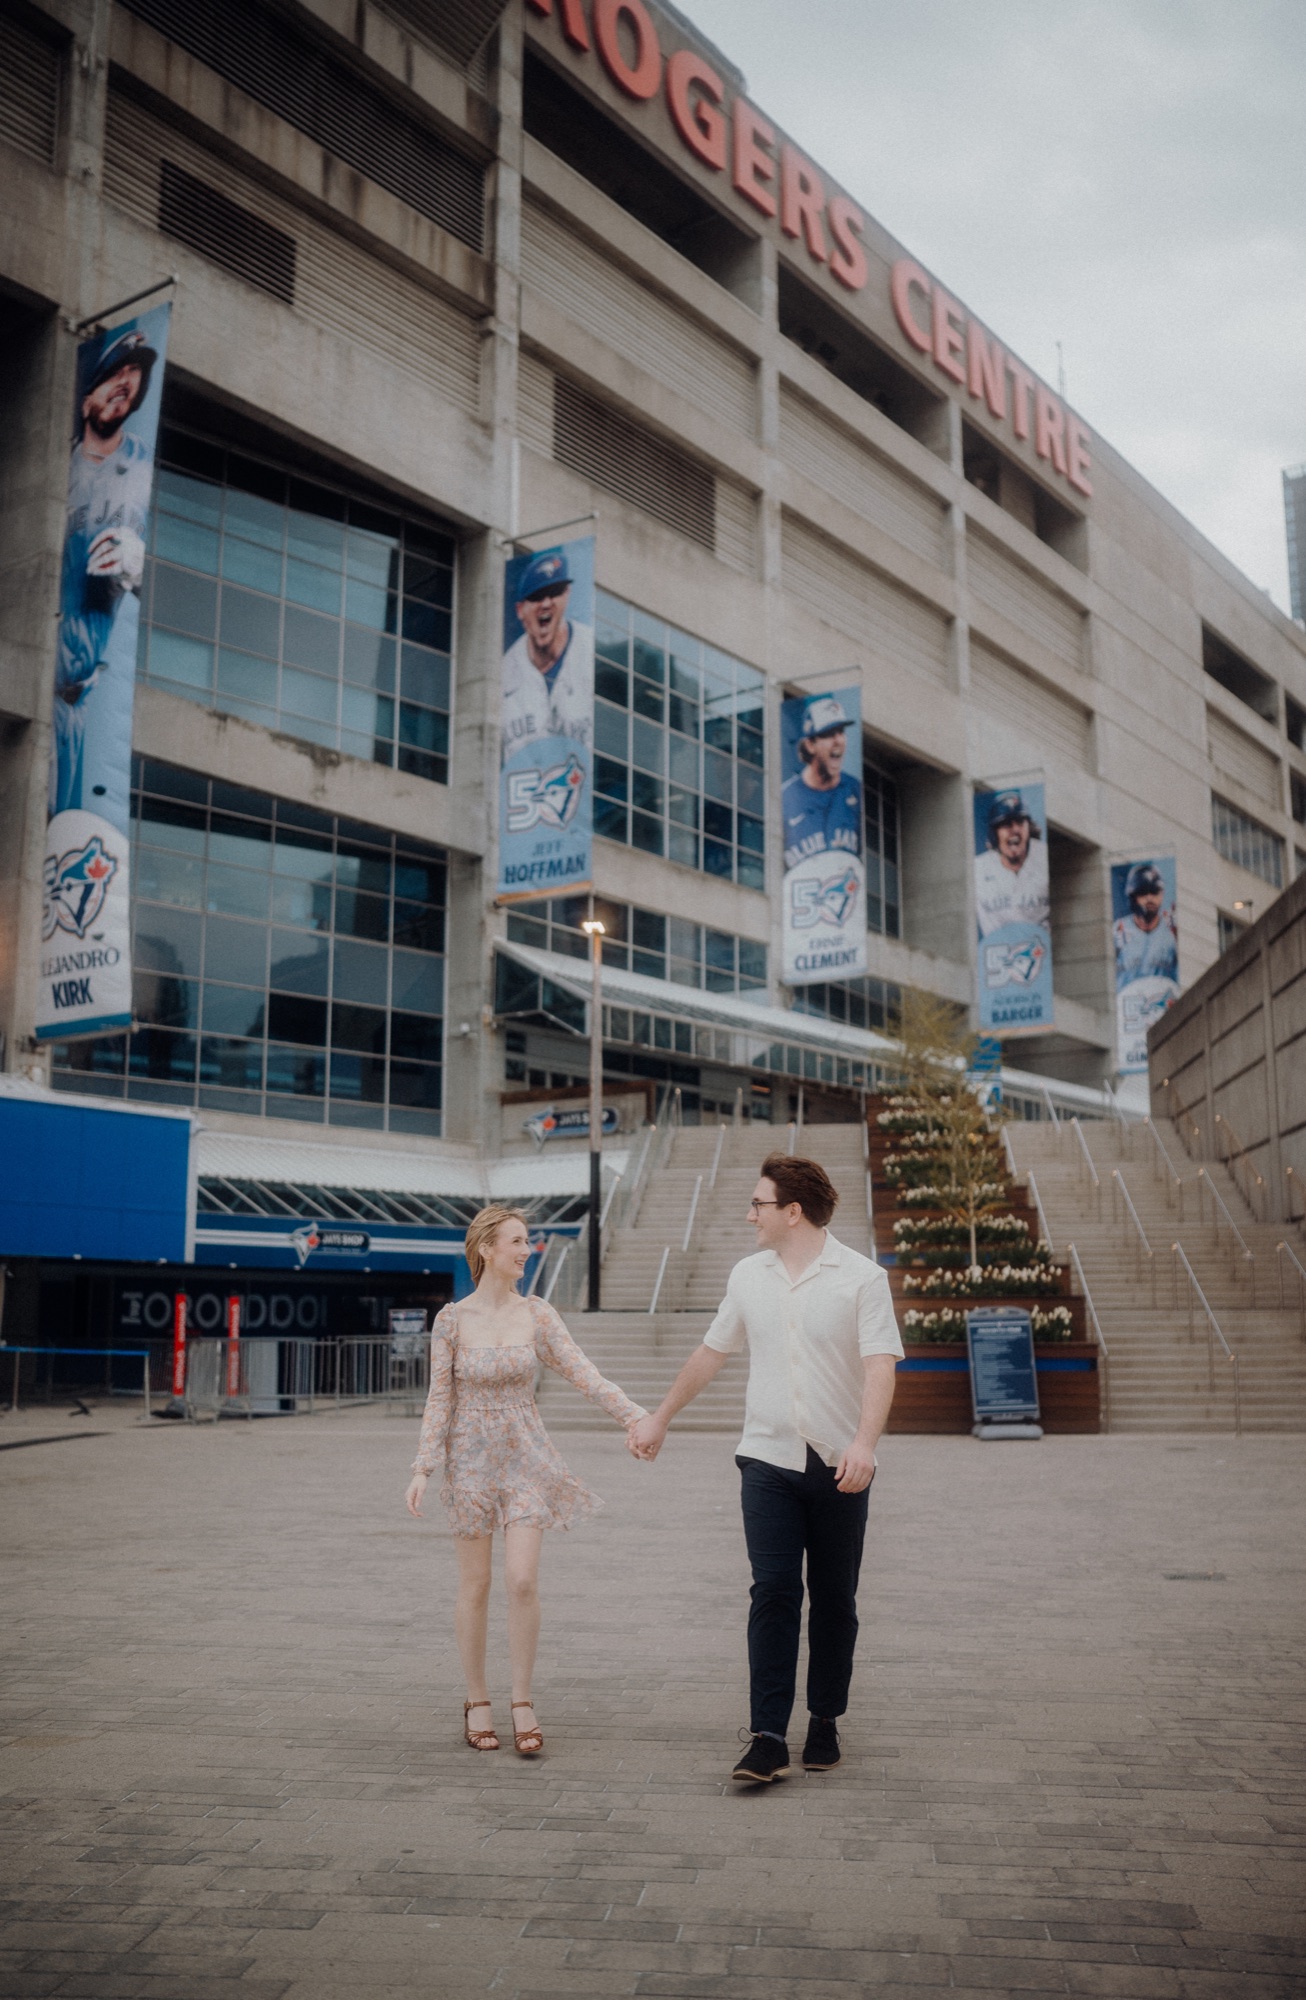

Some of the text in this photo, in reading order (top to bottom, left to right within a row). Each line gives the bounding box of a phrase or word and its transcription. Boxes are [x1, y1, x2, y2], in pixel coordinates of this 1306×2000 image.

[891, 259, 1094, 498] CENTRE
[505, 854, 586, 884] HOFFMAN
[795, 948, 858, 970] CLEMENT
[52, 977, 94, 1009] KIRK
[582, 1111, 610, 1124] SP
[342, 1234, 364, 1246] SHOP
